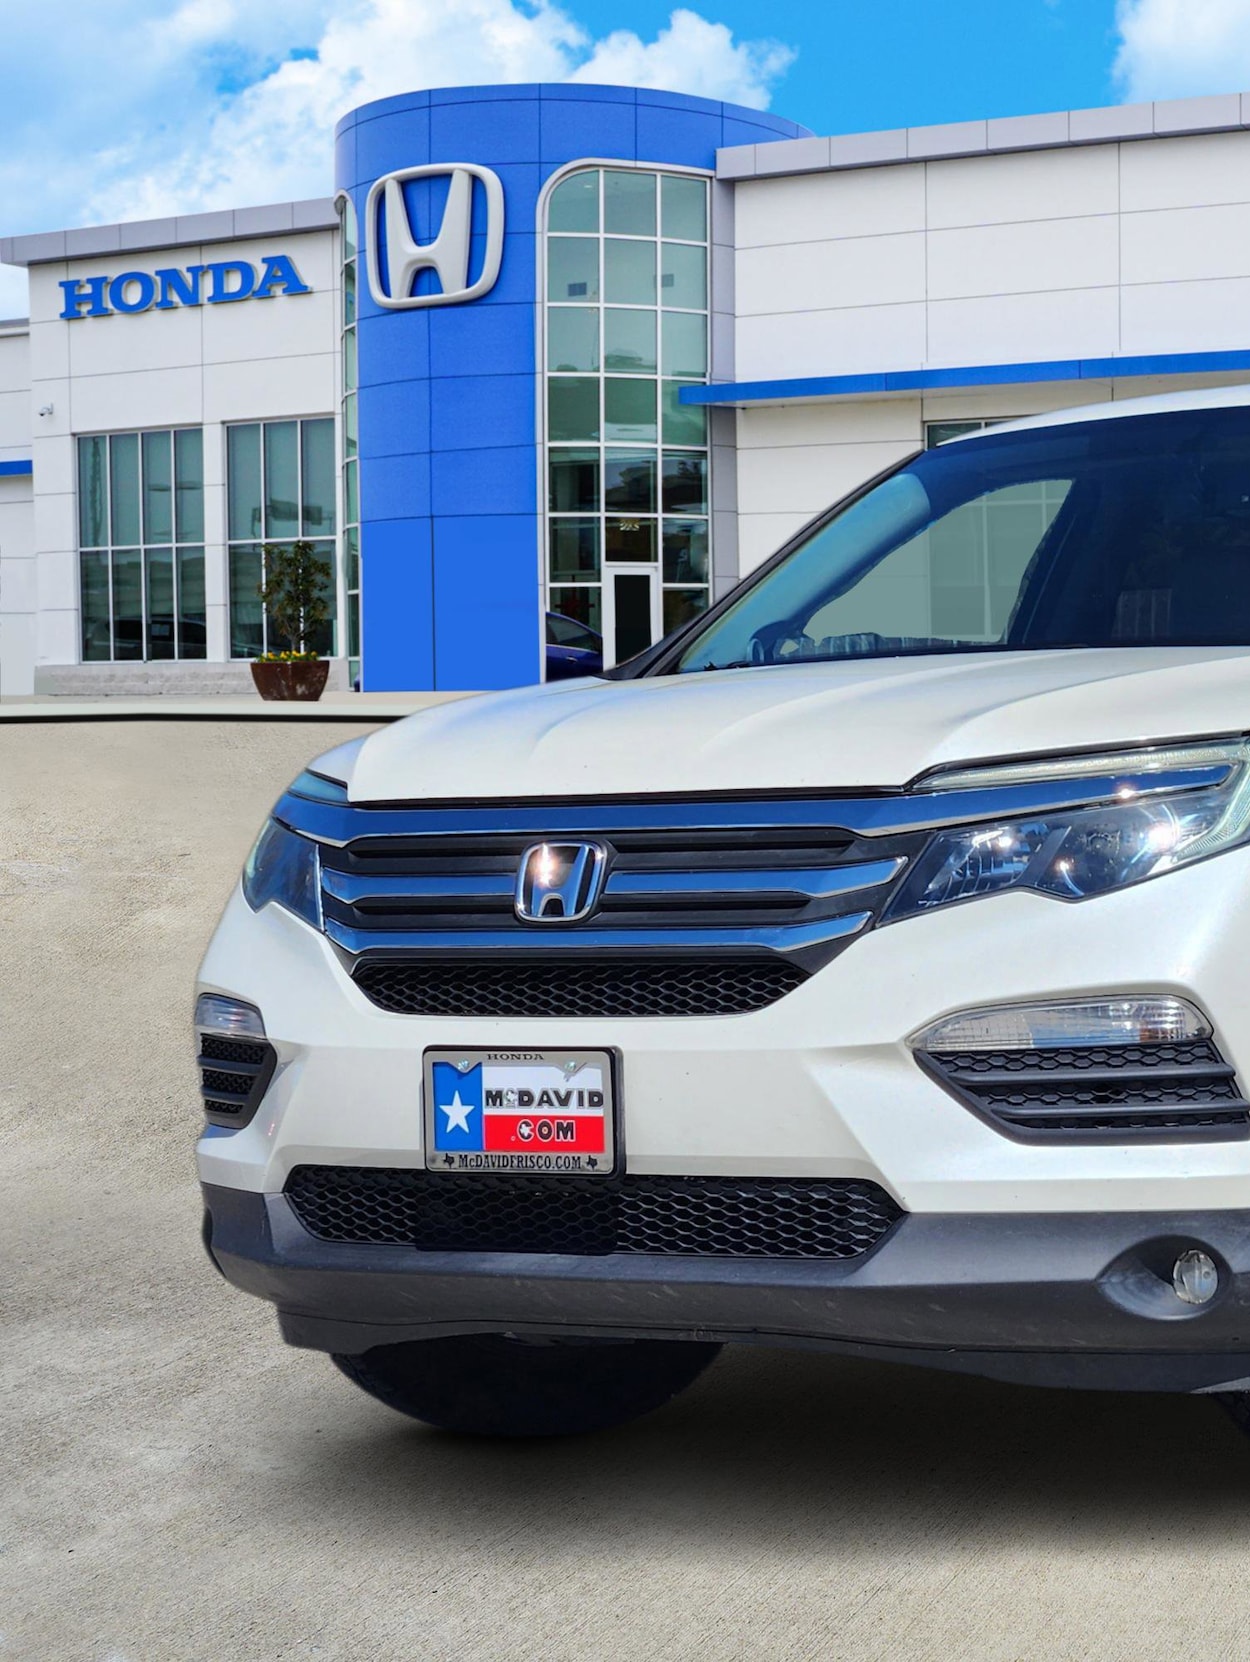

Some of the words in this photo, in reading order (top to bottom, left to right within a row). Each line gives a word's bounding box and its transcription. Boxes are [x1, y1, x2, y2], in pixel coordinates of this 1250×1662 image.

[58, 254, 309, 320] HONDA
[487, 1053, 545, 1061] HONDA
[458, 1153, 582, 1170] McDAVIDFRISCO.COM
